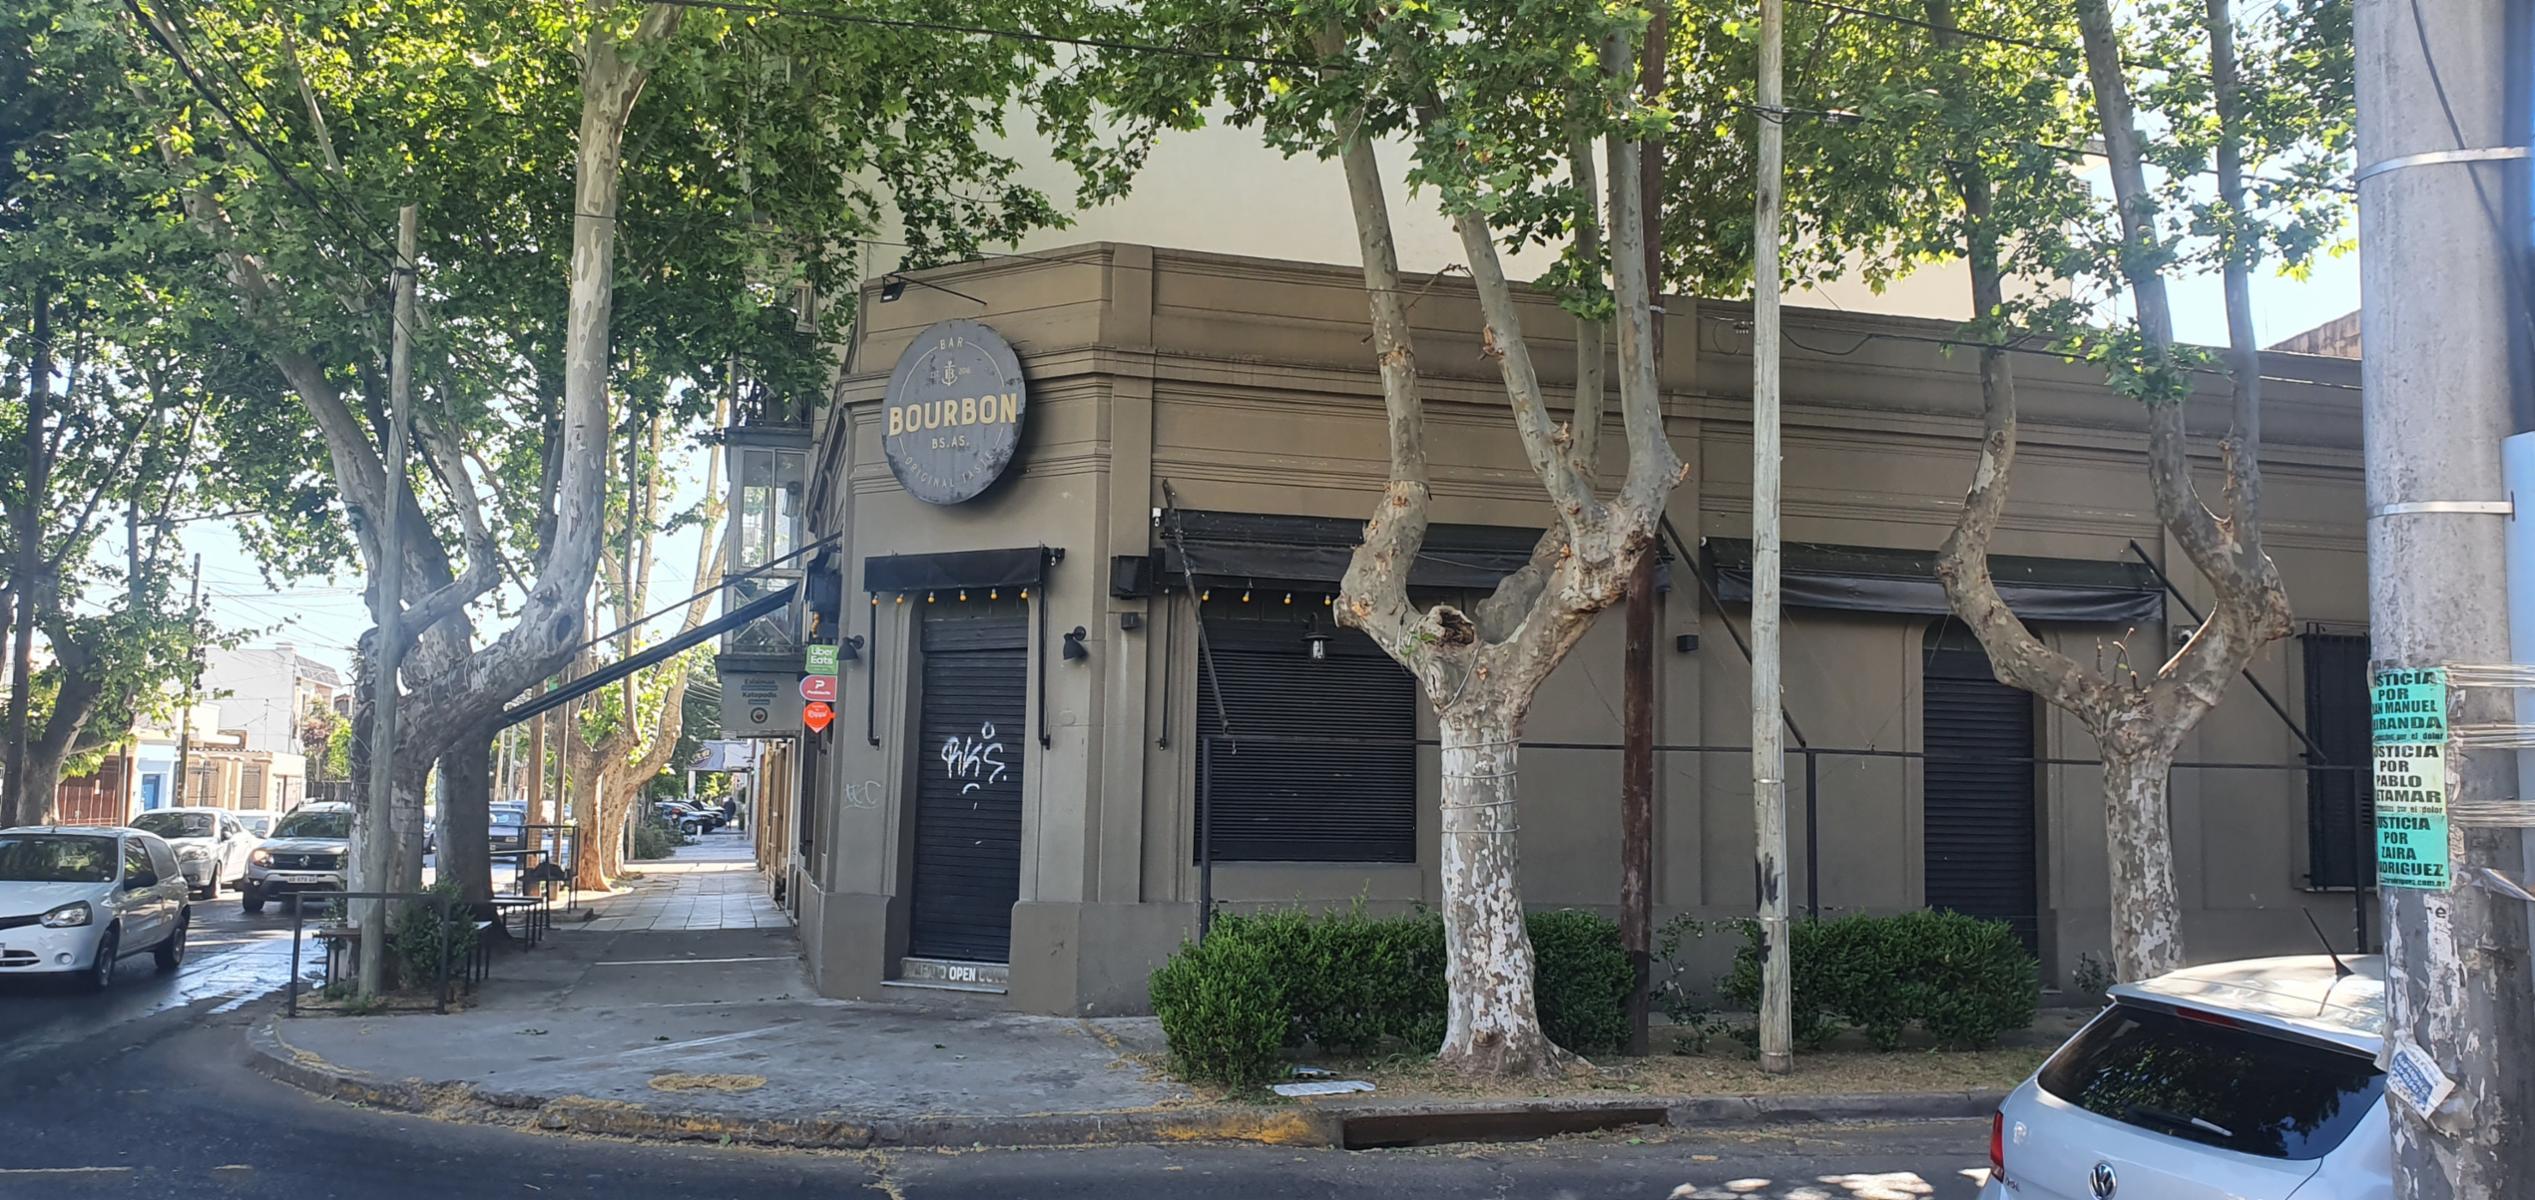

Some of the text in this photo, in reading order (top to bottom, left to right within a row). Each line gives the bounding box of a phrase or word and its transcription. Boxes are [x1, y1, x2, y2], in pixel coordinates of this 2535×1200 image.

[940, 336, 964, 349] BAR
[889, 393, 1018, 436] BOURBON
[904, 456, 955, 488] ORIGINAL
[2378, 687, 2409, 701] POR
[2385, 699, 2438, 714] MANUEL
[2380, 760, 2409, 772] POR
[2376, 774, 2422, 788] PABLO
[2384, 832, 2408, 845] POR
[2382, 846, 2417, 861] ZAIRA
[949, 966, 976, 982] OPEN
